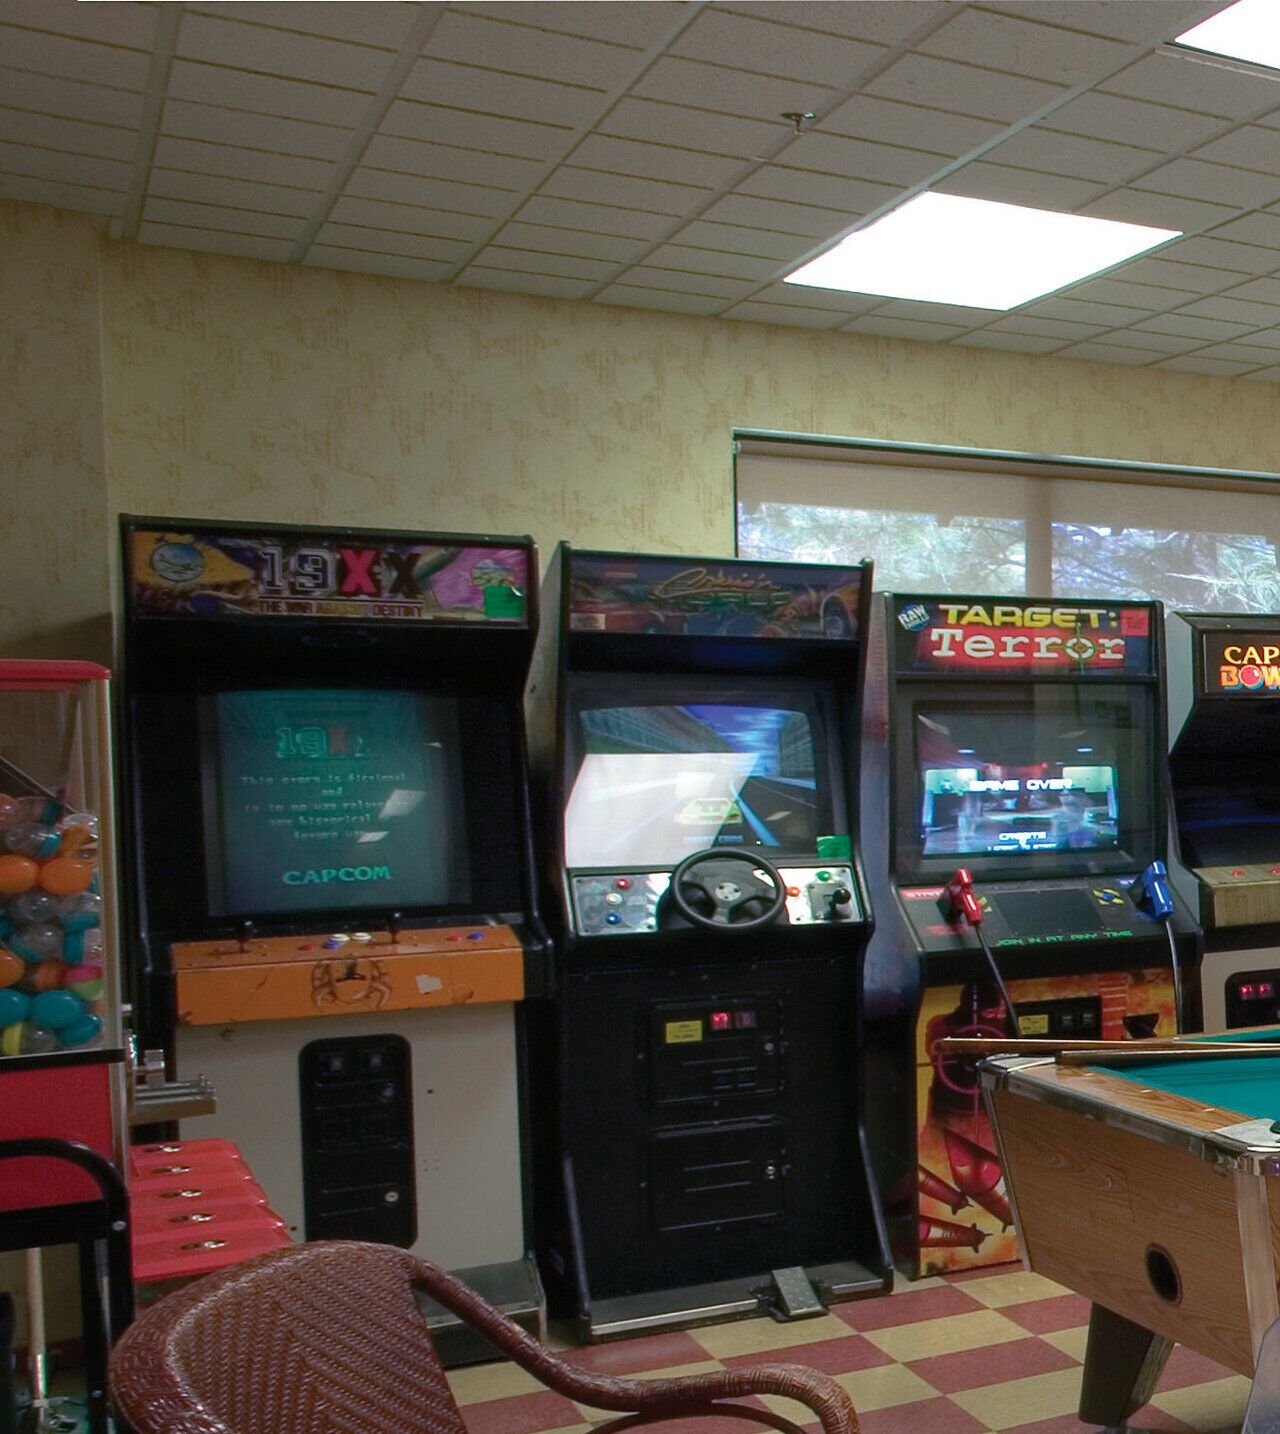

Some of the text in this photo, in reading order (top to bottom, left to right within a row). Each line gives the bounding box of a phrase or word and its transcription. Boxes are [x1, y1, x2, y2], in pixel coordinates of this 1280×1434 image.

[258, 545, 422, 595] 19XX
[259, 600, 283, 613] THE
[286, 601, 314, 614] WAR
[372, 603, 424, 617] DESTINY
[931, 628, 1125, 659] Terror
[970, 778, 1074, 791] GAME OVER
[283, 865, 392, 885] CAPCOM
[995, 937, 1023, 946] JOIN
[1028, 936, 1041, 944] IN
[1103, 930, 1133, 938] TIME
